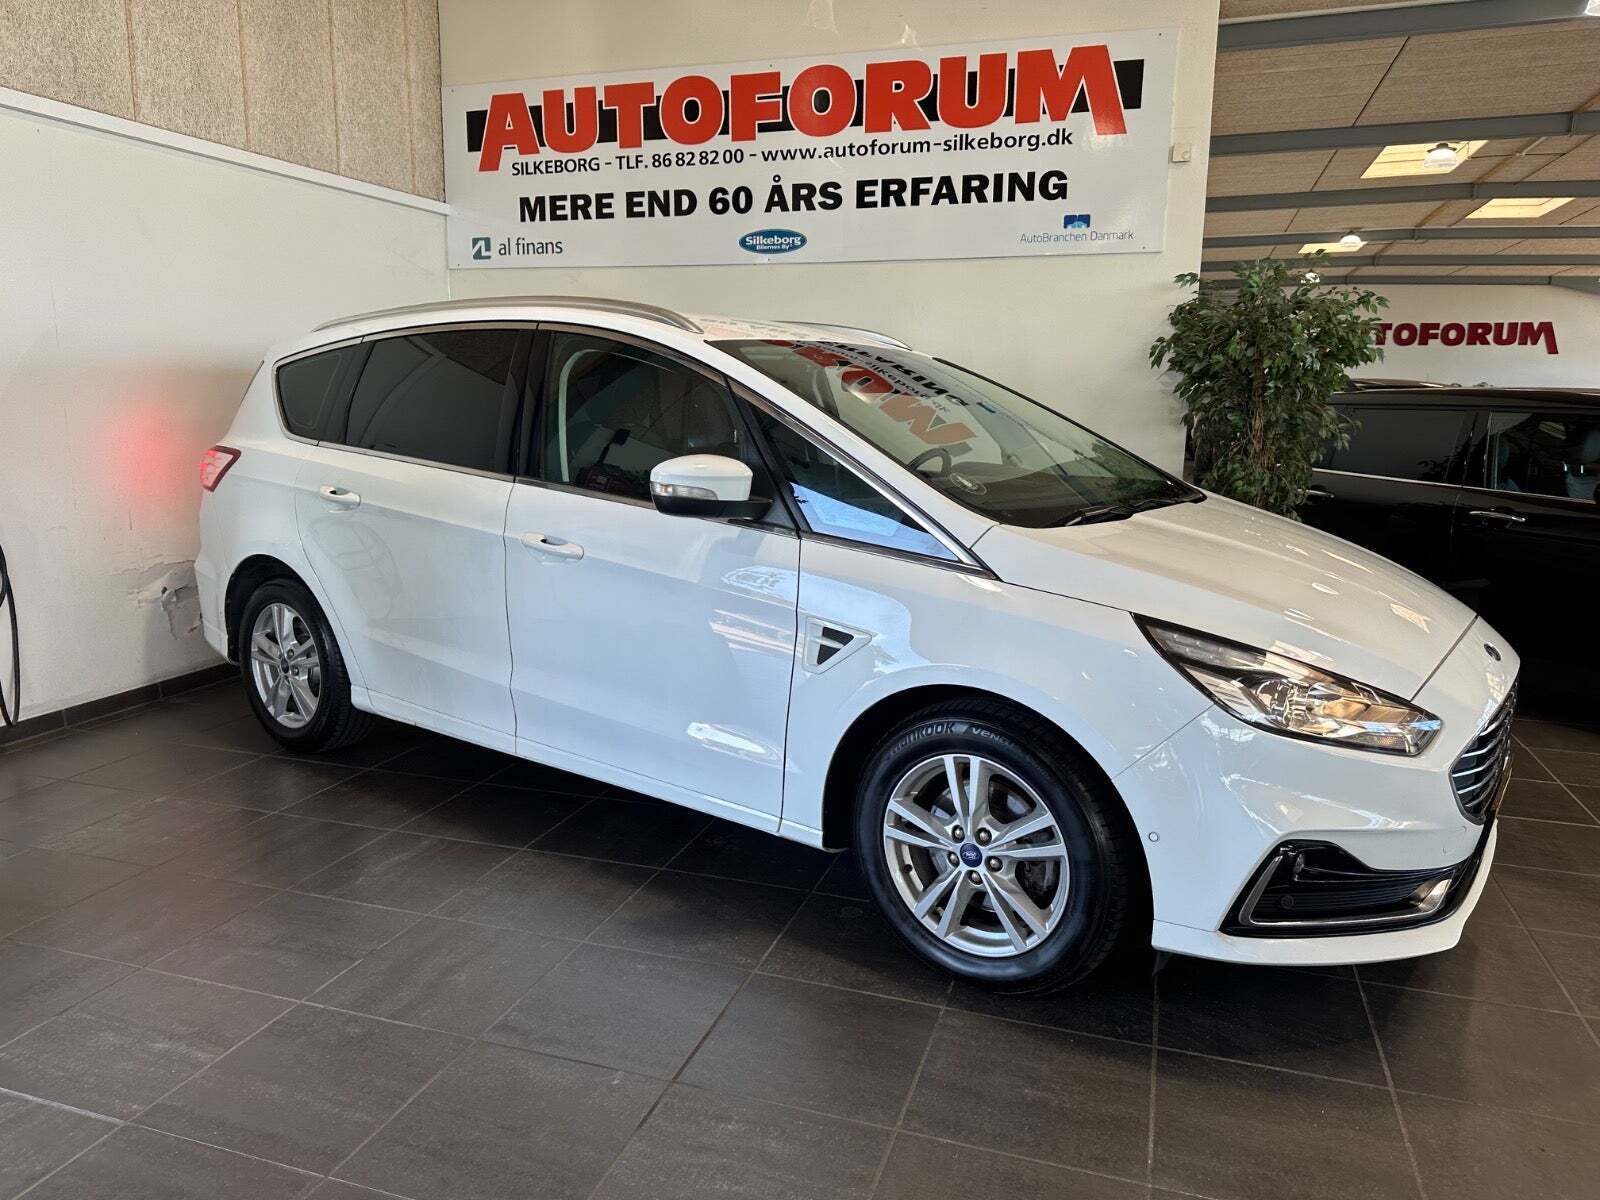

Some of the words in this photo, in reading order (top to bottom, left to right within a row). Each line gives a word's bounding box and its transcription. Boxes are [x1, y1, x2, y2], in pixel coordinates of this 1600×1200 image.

[478, 44, 1127, 172] AUTOFORUM
[511, 157, 600, 176] SILKEBORG
[615, 154, 648, 171] TLF.
[652, 152, 672, 168] 86
[675, 151, 696, 167] 82
[699, 150, 720, 166] 82
[722, 148, 744, 164] 00
[761, 128, 1073, 162] www.autoforum-silkeborg.dk
[519, 193, 614, 223] MERE
[626, 189, 698, 218] END
[709, 185, 752, 214] 60
[764, 174, 843, 213] ÅRS
[855, 169, 1068, 209] ERFARING
[498, 237, 511, 256] al
[515, 237, 563, 255] finans
[745, 235, 801, 246] Silkeborg
[1020, 232, 1087, 244] AutoBranchen
[1090, 230, 1135, 242] Danmark
[1374, 321, 1559, 354] TOFORUM
